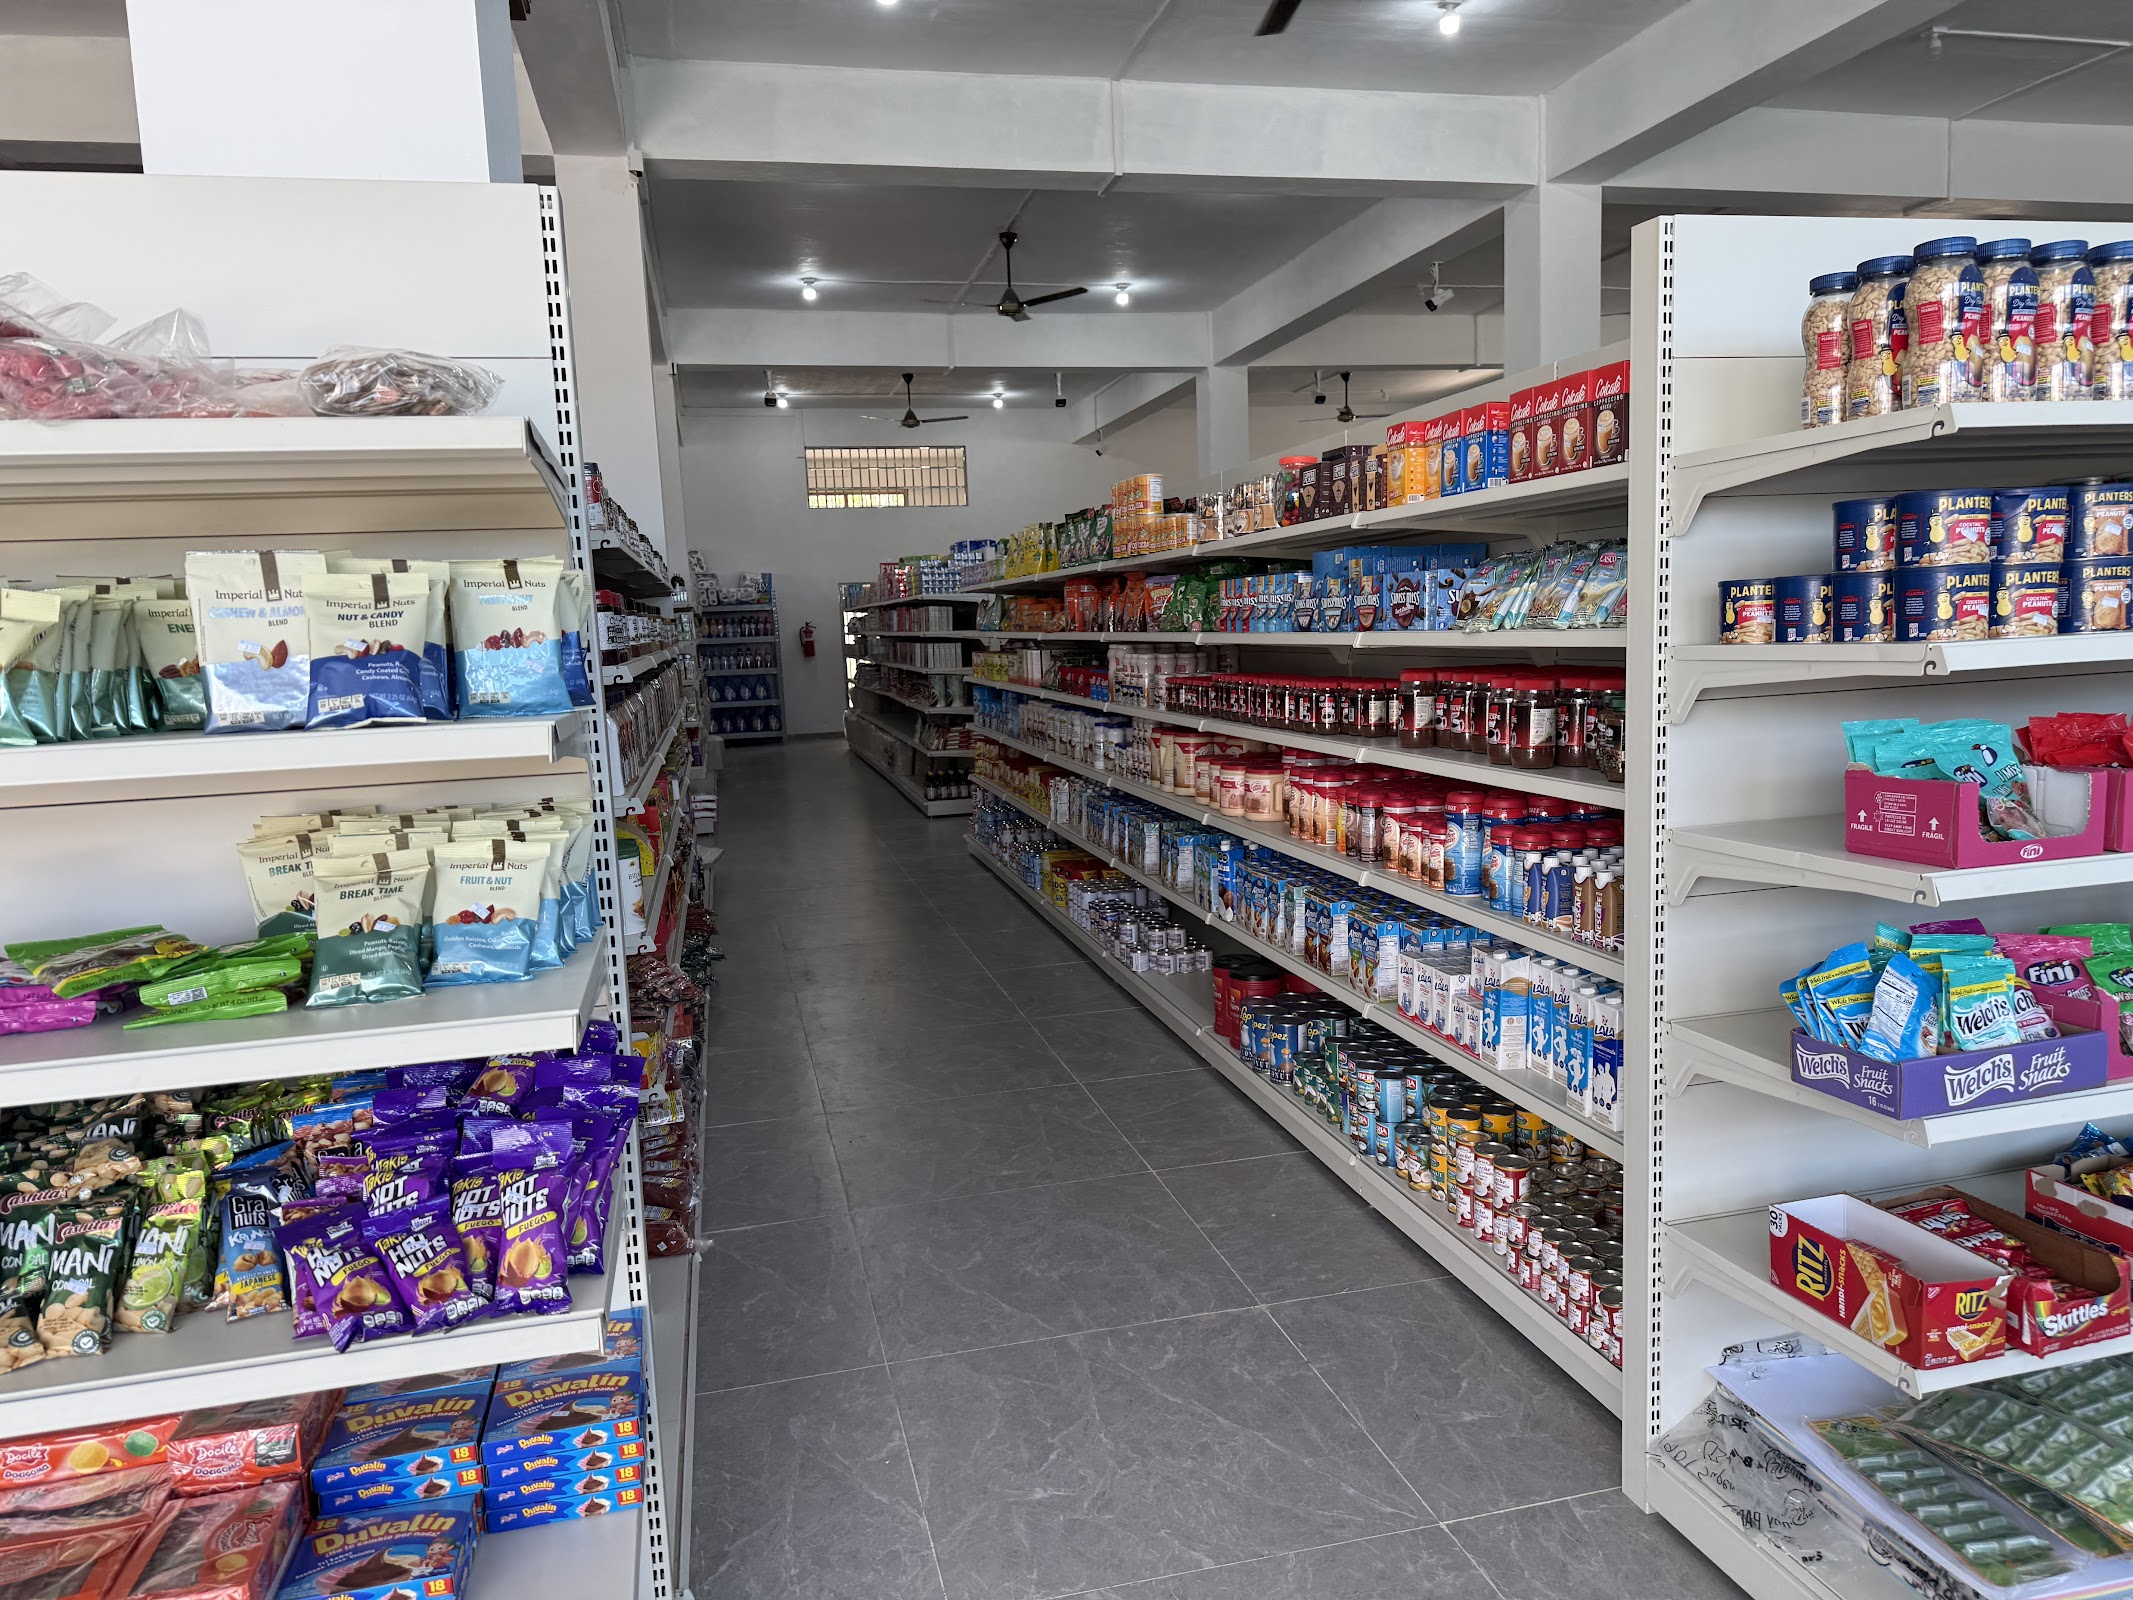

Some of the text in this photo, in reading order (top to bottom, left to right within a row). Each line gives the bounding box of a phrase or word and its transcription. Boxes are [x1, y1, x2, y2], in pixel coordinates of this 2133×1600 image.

[2084, 491, 2133, 504] PLANTERS
[2082, 566, 2131, 578] PLANTERS
[464, 579, 546, 589] Imperial Nuts
[1731, 585, 1771, 598] PLANTE
[215, 589, 304, 601] Imperial Nut
[326, 598, 416, 610] Imperial Nuts
[148, 608, 189, 620] Imperial
[337, 613, 357, 621] NUT
[370, 610, 404, 620] CANDY
[268, 618, 289, 627] BLEND
[368, 619, 398, 629] BLEND
[1850, 822, 1873, 832] FRAGILE
[259, 853, 298, 864] Imperial
[268, 863, 302, 877] BREAK
[449, 862, 528, 871] Imperial Nuts
[334, 876, 375, 889] Imperial
[460, 876, 485, 885] FRUIT
[493, 876, 512, 885] NUT
[340, 885, 404, 900] BREAK TIME
[2028, 960, 2075, 985] Fini
[1956, 999, 2011, 1035] Welch's
[1594, 1025, 1615, 1038] LALA
[1798, 1051, 1849, 1078] Welch's
[2029, 1047, 2066, 1071] Fruit
[1860, 1065, 1889, 1082] Fruit
[1948, 1055, 2012, 1101] Welch's
[2018, 1061, 2072, 1090] Snacks
[1853, 1077, 1894, 1097] Snacks
[1867, 1095, 1877, 1107] 16
[452, 1176, 484, 1195] Takis
[500, 1174, 539, 1204] HOT
[453, 1184, 496, 1207] HOT
[231, 1196, 264, 1215] Gra
[234, 1209, 266, 1228] nuts
[464, 1220, 495, 1231] FUEGO
[518, 1214, 547, 1233] FUEGO
[1769, 1210, 1779, 1230] 30
[1, 1253, 48, 1269] CON SAL
[395, 1234, 447, 1279] NUTS
[424, 1249, 452, 1271] FUEGO
[342, 1258, 370, 1275] FUEGO
[1796, 1232, 1826, 1302] RITZ
[240, 1273, 277, 1288] JAPANESE
[1955, 1291, 1988, 1317] RITZ
[2043, 1301, 2109, 1337] Skittles
[503, 1379, 522, 1389] 18
[505, 1373, 630, 1409] Duvalín
[545, 1390, 576, 1400] cambio
[577, 1387, 594, 1395] por
[346, 1396, 476, 1433] Duvalín
[386, 1415, 419, 1425] cambio
[617, 1421, 633, 1433] 18
[518, 1433, 554, 1449] Duvalín
[5, 1445, 43, 1463] Docile
[197, 1439, 238, 1460] Docile
[453, 1446, 470, 1458] 18
[622, 1443, 638, 1455] 18
[349, 1460, 387, 1476] Duvalín
[523, 1456, 558, 1471] Duvalín
[461, 1469, 477, 1482] 18
[619, 1466, 634, 1478] 18
[357, 1483, 394, 1499] Duvalín
[520, 1480, 555, 1495] Duvalín
[620, 1489, 636, 1501] 18
[521, 1503, 557, 1517] Duvalín
[316, 1518, 338, 1530] 18
[313, 1512, 456, 1555] Duvalín
[357, 1534, 393, 1548] cambio
[394, 1532, 413, 1540] por
[428, 1579, 446, 1592] 18
